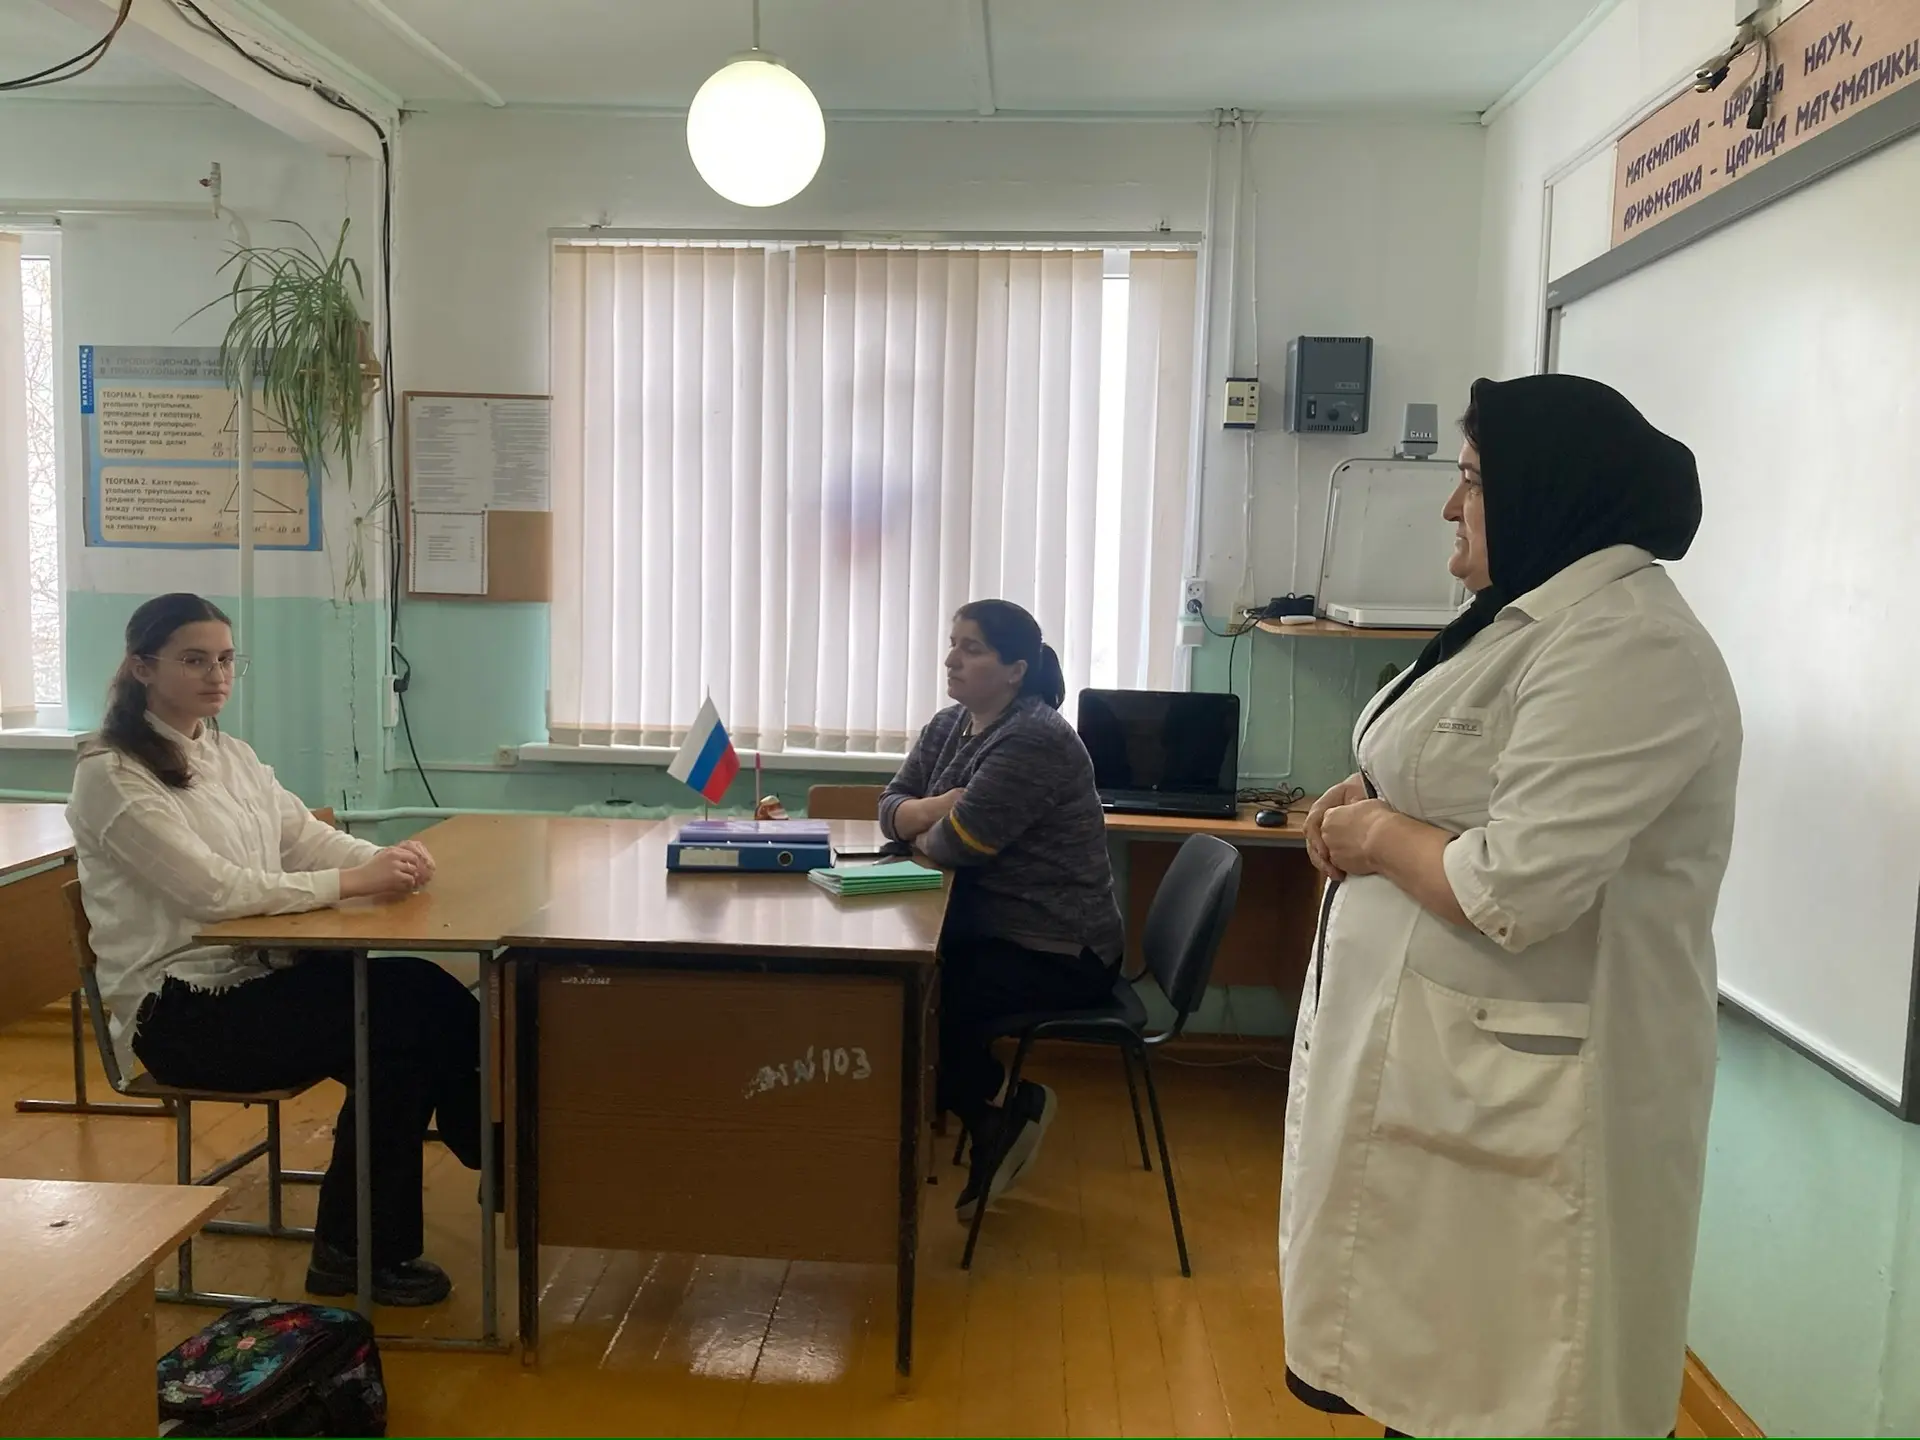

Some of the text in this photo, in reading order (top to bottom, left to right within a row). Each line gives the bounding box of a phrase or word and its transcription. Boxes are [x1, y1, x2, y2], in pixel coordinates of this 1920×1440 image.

[1625, 118, 1700, 188] МАТЕМАТИКА
[1804, 20, 1863, 76] НАУК,
[1623, 164, 1703, 232] АРИФМЕТИКА
[1725, 115, 1787, 178] ЦАРИЦА
[103, 391, 137, 399] ТЕОРЕМА
[105, 477, 140, 485] ТЕОРЕМА
